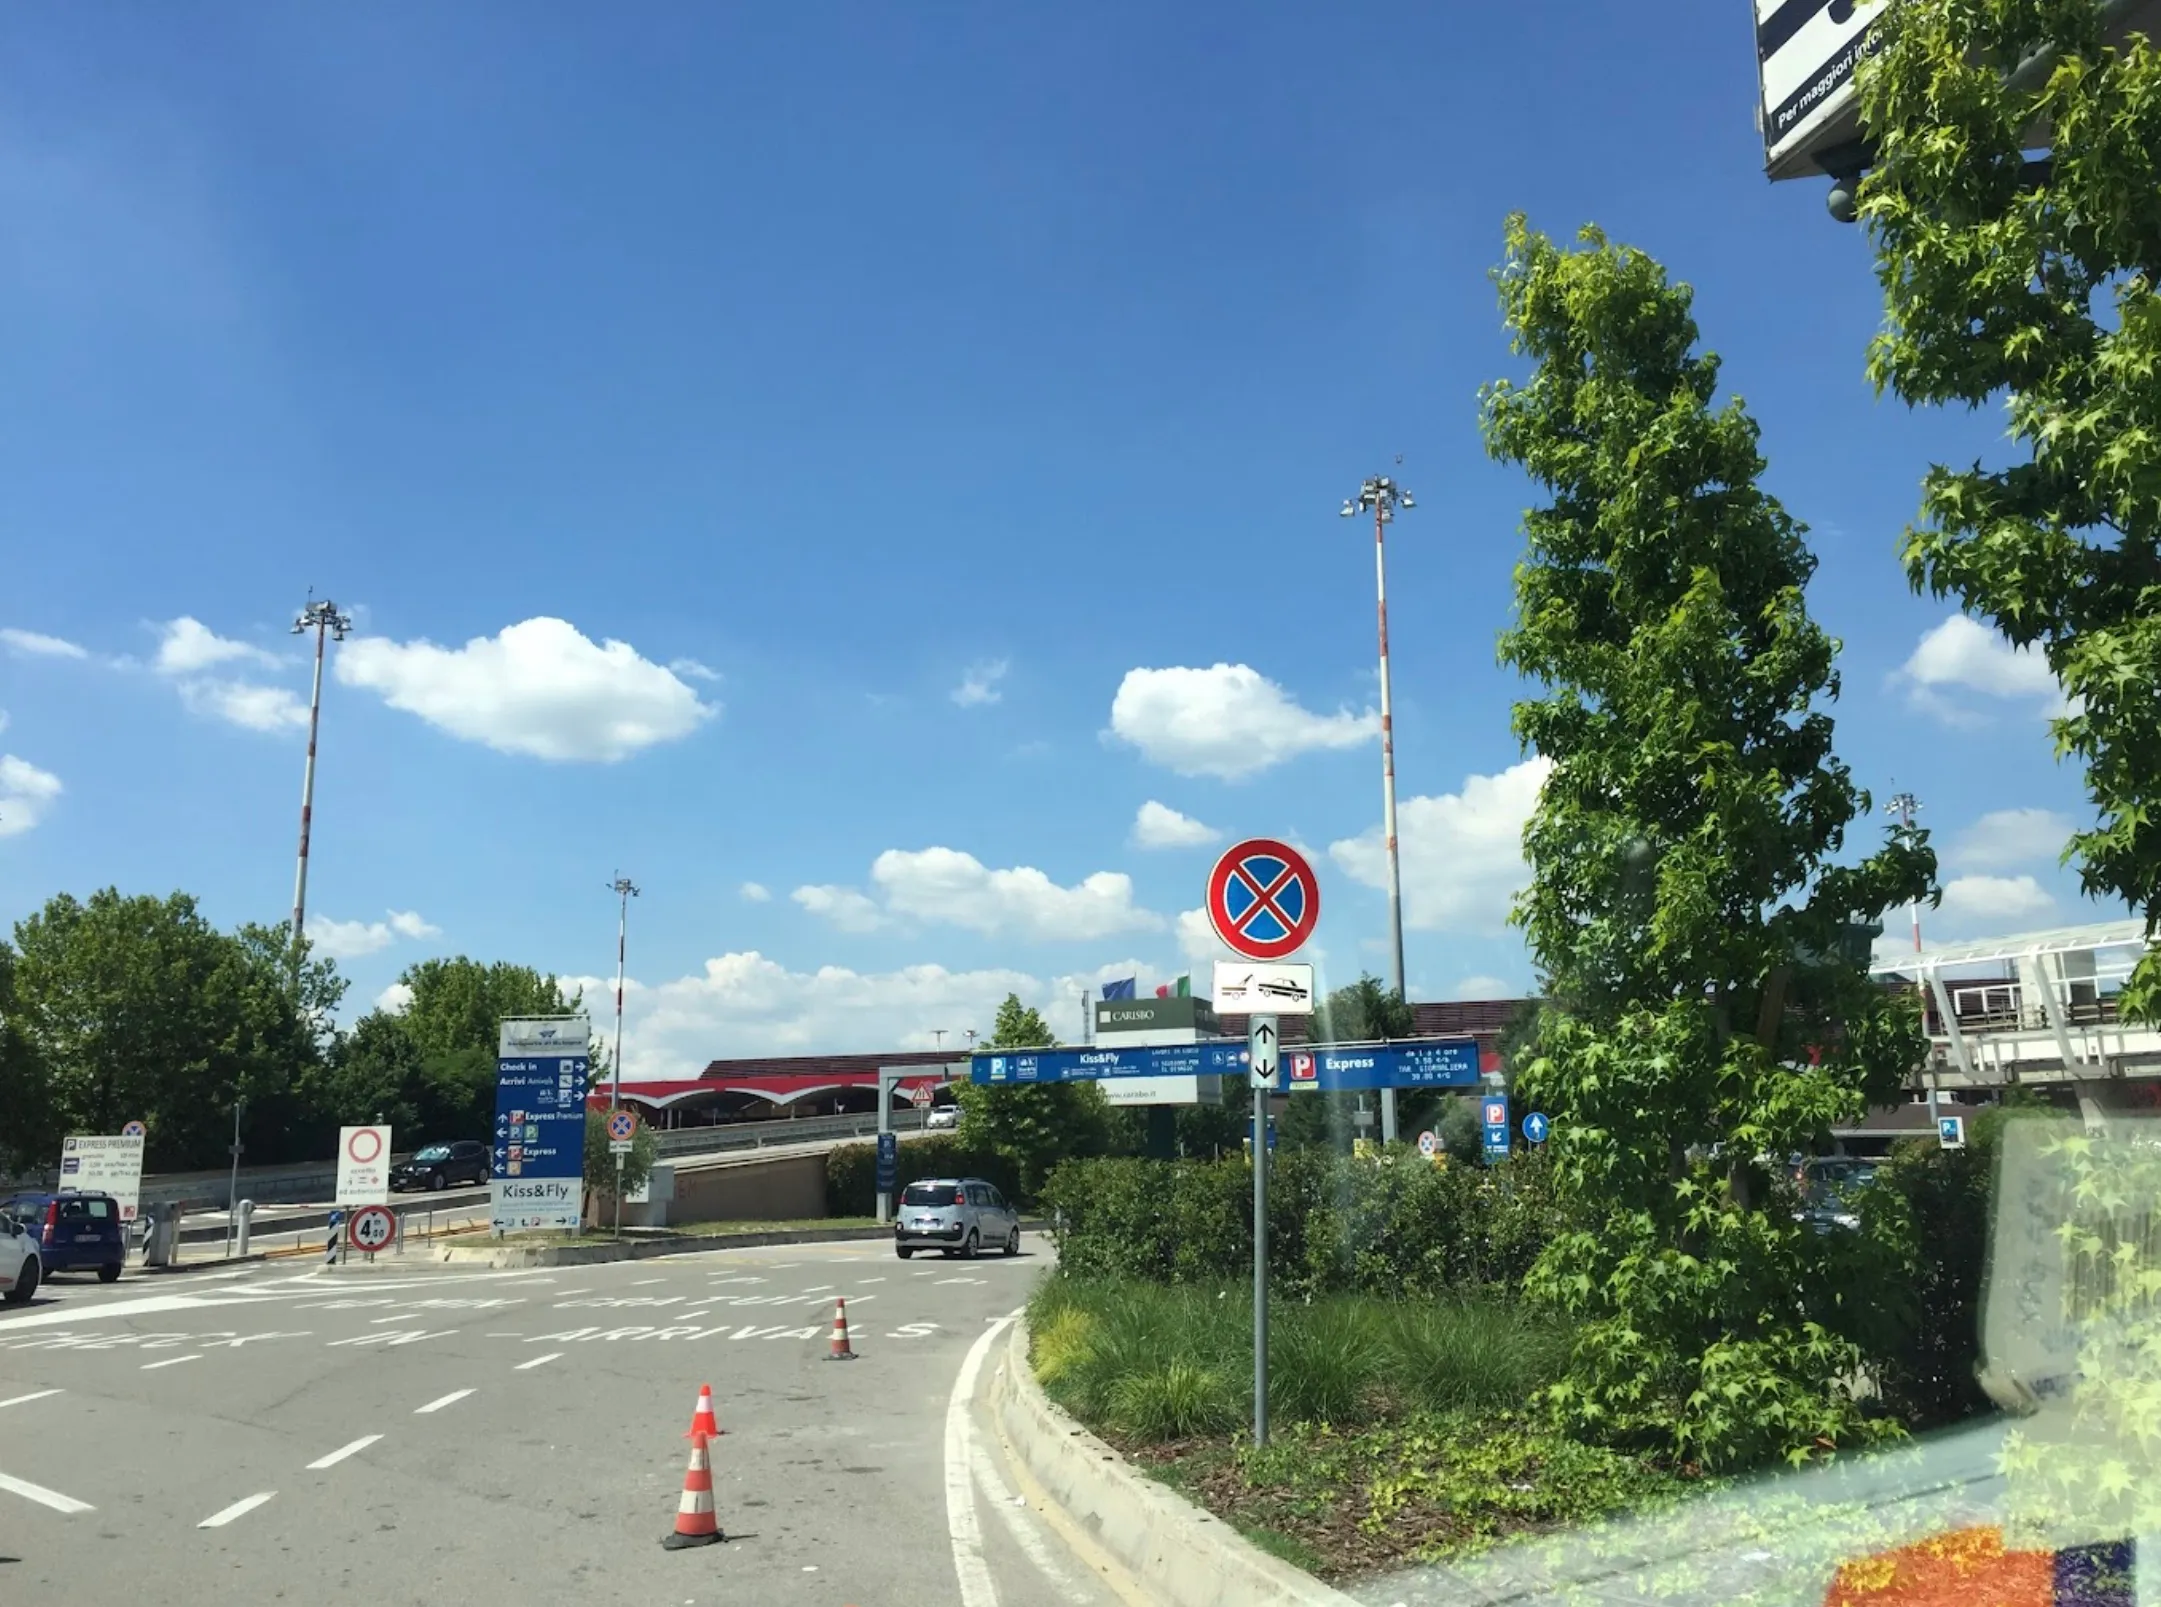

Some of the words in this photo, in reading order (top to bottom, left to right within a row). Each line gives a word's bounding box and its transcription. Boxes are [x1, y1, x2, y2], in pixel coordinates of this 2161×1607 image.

[1778, 102, 1799, 129] Per
[1799, 50, 1853, 110] maggiori
[1112, 1009, 1155, 1021] CARISBO
[1080, 1053, 1120, 1066] Kiss&Fly
[1326, 1057, 1375, 1073] Express
[500, 1061, 527, 1072] Check
[528, 1061, 538, 1071] in
[500, 1076, 526, 1086] Arrivi
[525, 1112, 555, 1123] Express
[79, 1140, 107, 1149] EXPRESS
[108, 1139, 140, 1149] PREMIUM
[523, 1147, 557, 1158] Express
[502, 1183, 569, 1199] Kiss&Fly
[360, 1219, 371, 1238] 4
[0, 1331, 314, 1349] CHECK
[326, 1330, 462, 1346] IN
[522, 1323, 942, 1343] ARRIVALS
